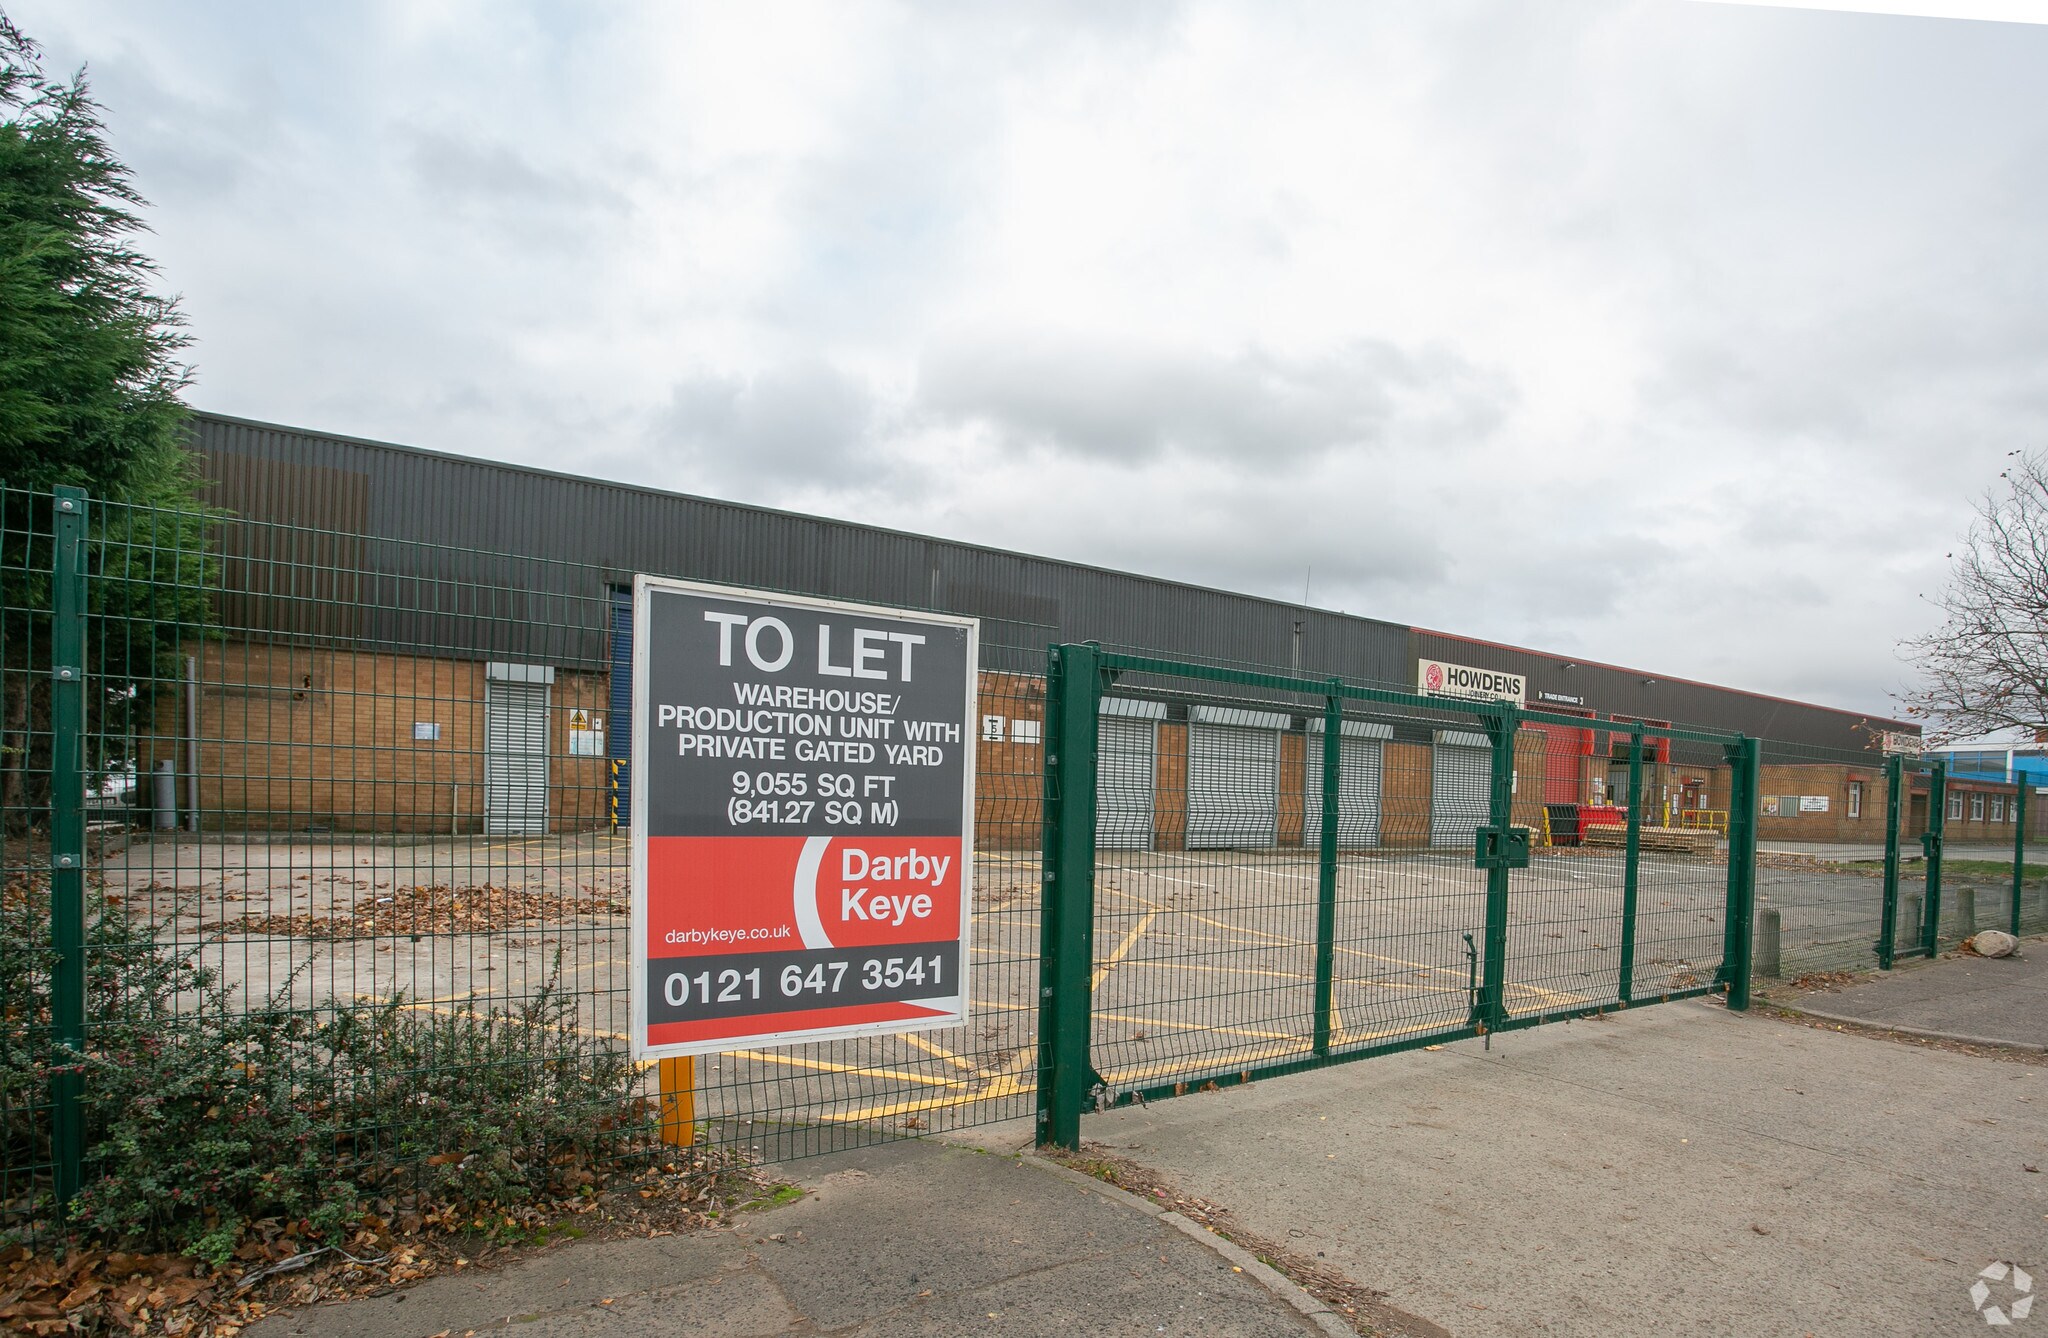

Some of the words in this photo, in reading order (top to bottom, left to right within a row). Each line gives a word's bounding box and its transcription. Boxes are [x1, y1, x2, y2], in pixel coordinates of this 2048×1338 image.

[704, 611, 794, 672] TO
[818, 624, 926, 682] LET
[1447, 667, 1520, 695] HOWDENS
[733, 682, 901, 715] WAREHOUSE/
[1544, 692, 1557, 700] TRADE
[1557, 694, 1578, 704] ENTRANCE
[658, 704, 831, 736] PRODUCTION
[839, 717, 894, 739] UNIT
[903, 720, 960, 743] WITH
[679, 734, 786, 760] PRIVATE
[795, 740, 875, 764] GATED
[884, 744, 943, 767] YARD
[732, 771, 808, 798] 9,055
[817, 773, 855, 798] SQ
[864, 776, 896, 797] FT
[727, 797, 815, 826] (841.27
[824, 802, 862, 825] SQ
[871, 800, 899, 827] M)
[842, 848, 951, 887] Darby
[841, 888, 932, 926] Keye
[665, 925, 791, 944] darbykeye.co.uk
[664, 968, 761, 1007] 0121
[780, 961, 848, 997] 647
[862, 955, 942, 990] 3541
